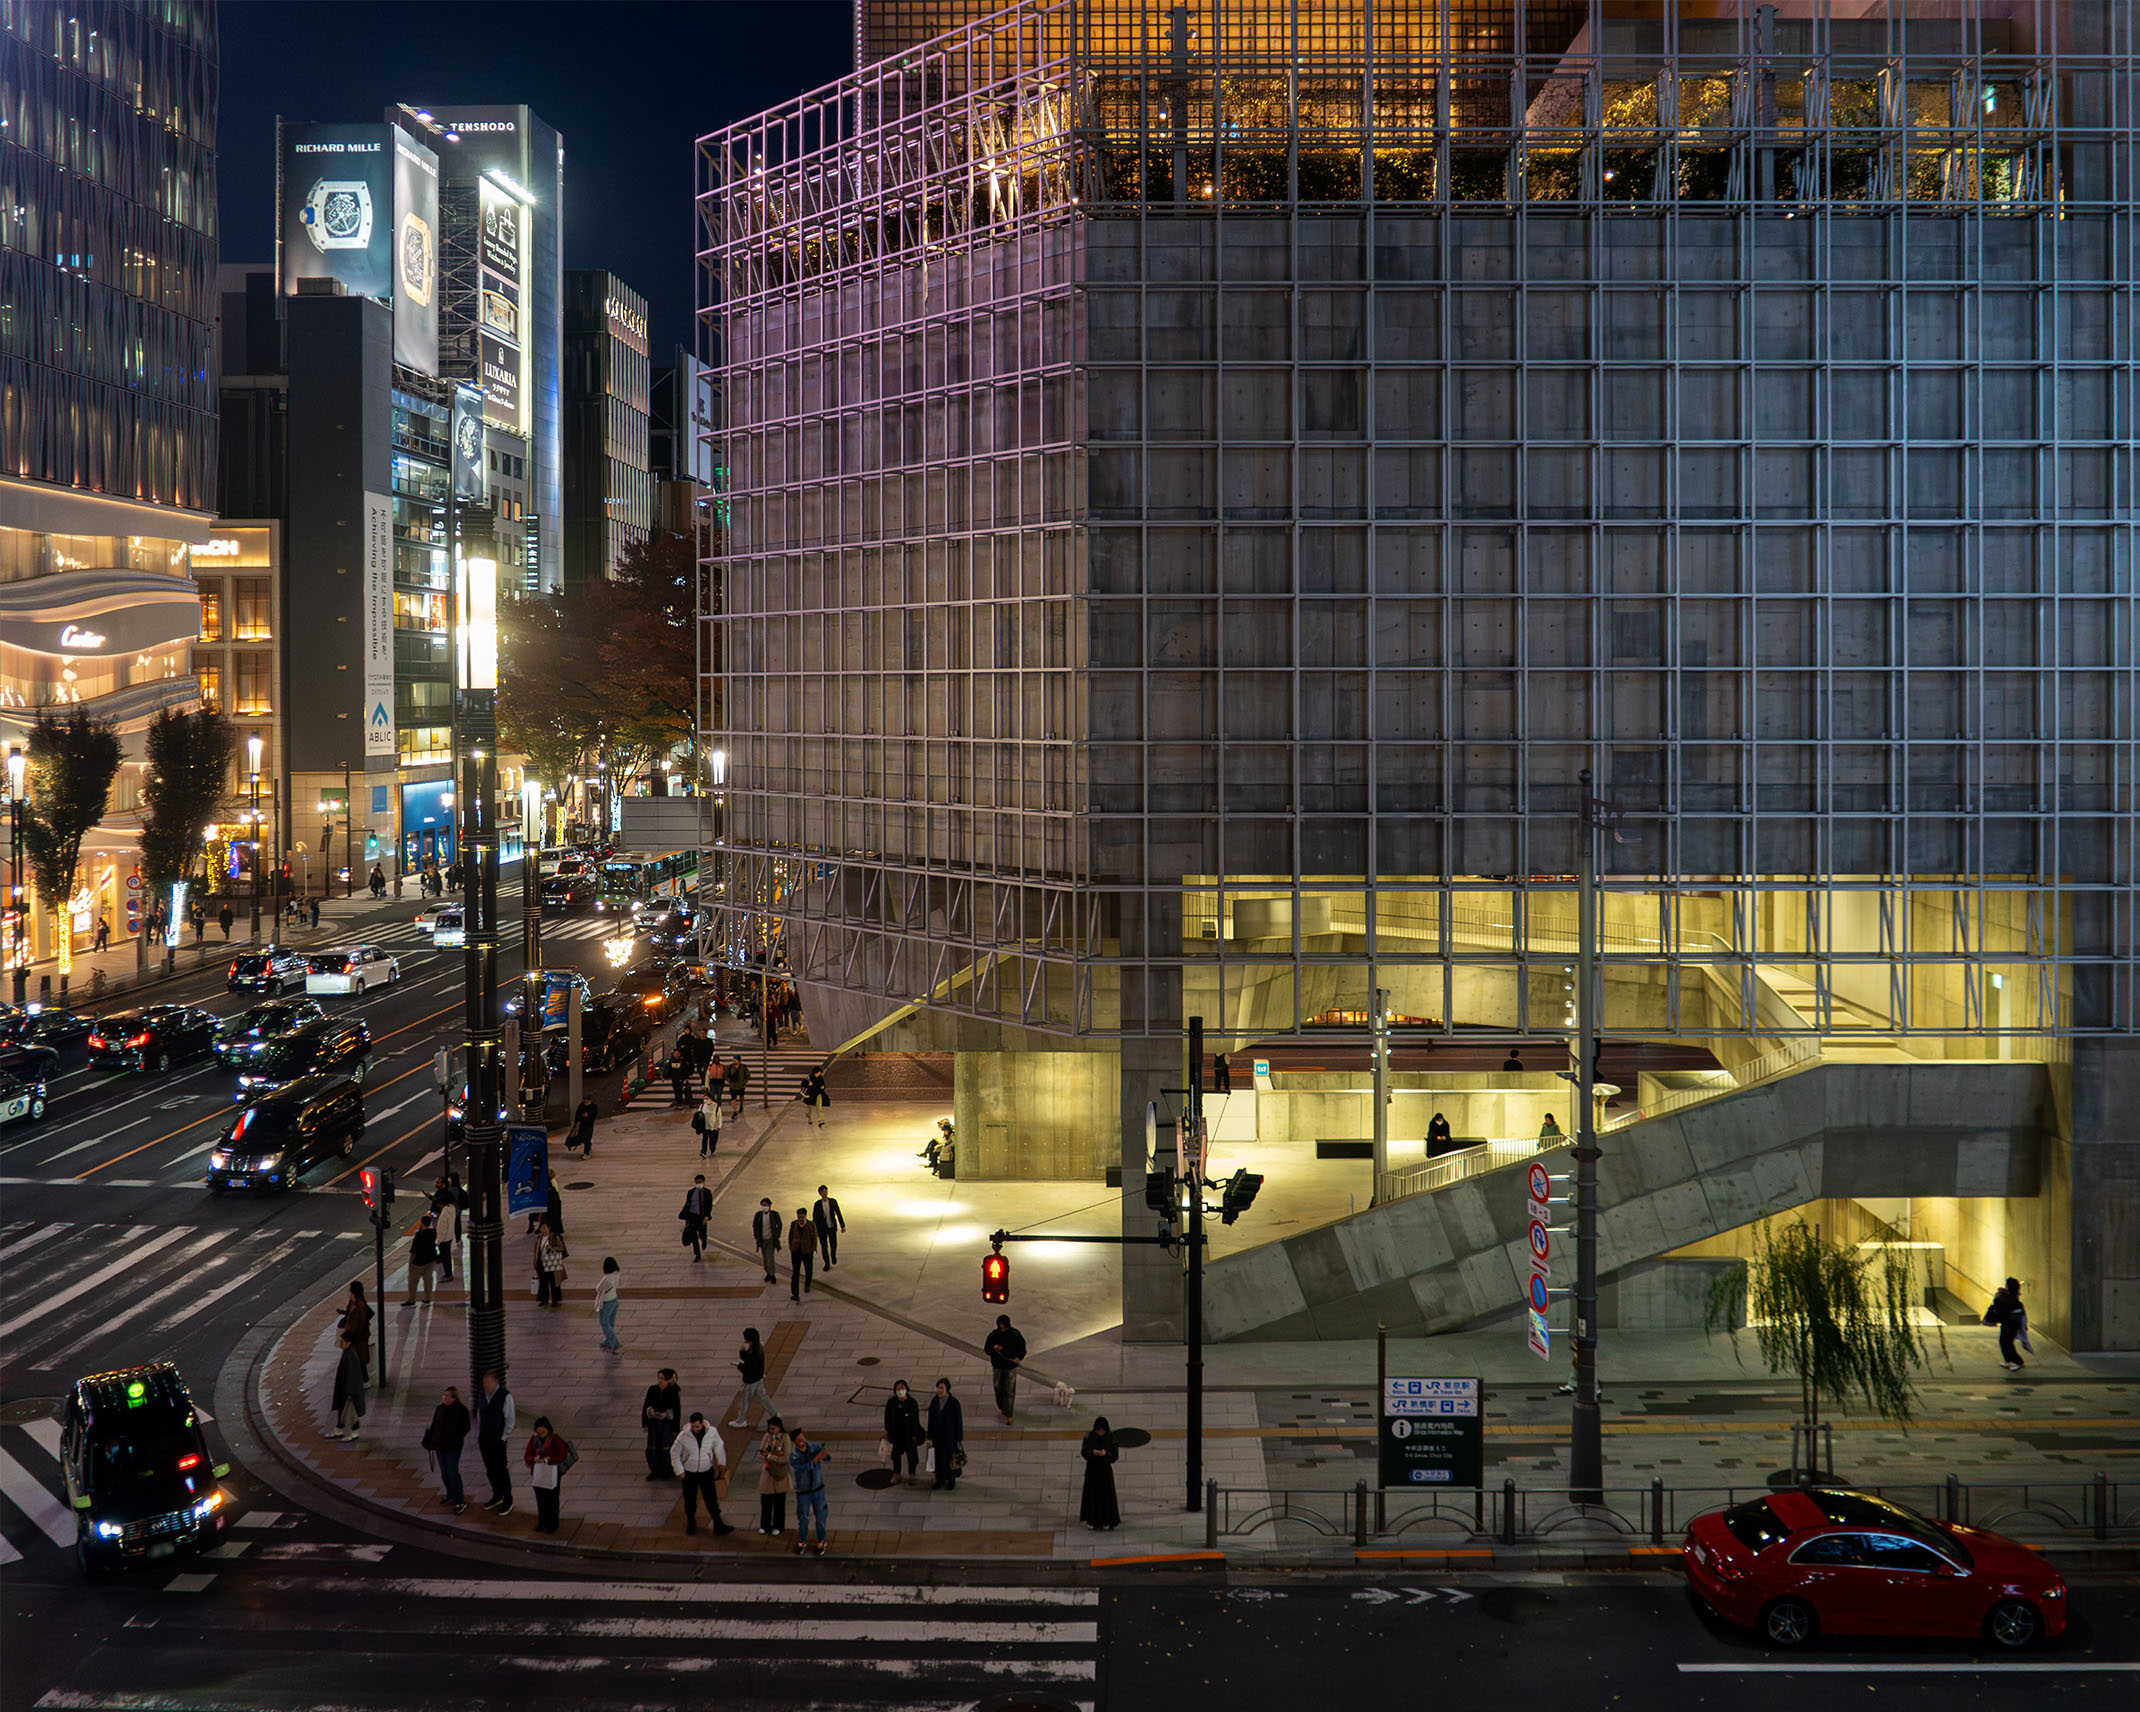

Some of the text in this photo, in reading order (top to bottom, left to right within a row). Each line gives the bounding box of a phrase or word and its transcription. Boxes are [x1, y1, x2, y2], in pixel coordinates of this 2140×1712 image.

[449, 122, 515, 132] TENSHODO
[295, 143, 381, 154] RICHARD MILLE
[484, 361, 518, 389] LUXARIA
[370, 507, 378, 568] Achieving
[370, 594, 378, 661] Impossible
[368, 731, 392, 743] ABLIC
[1425, 1381, 1441, 1390] JR
[1392, 1400, 1407, 1408] JR
